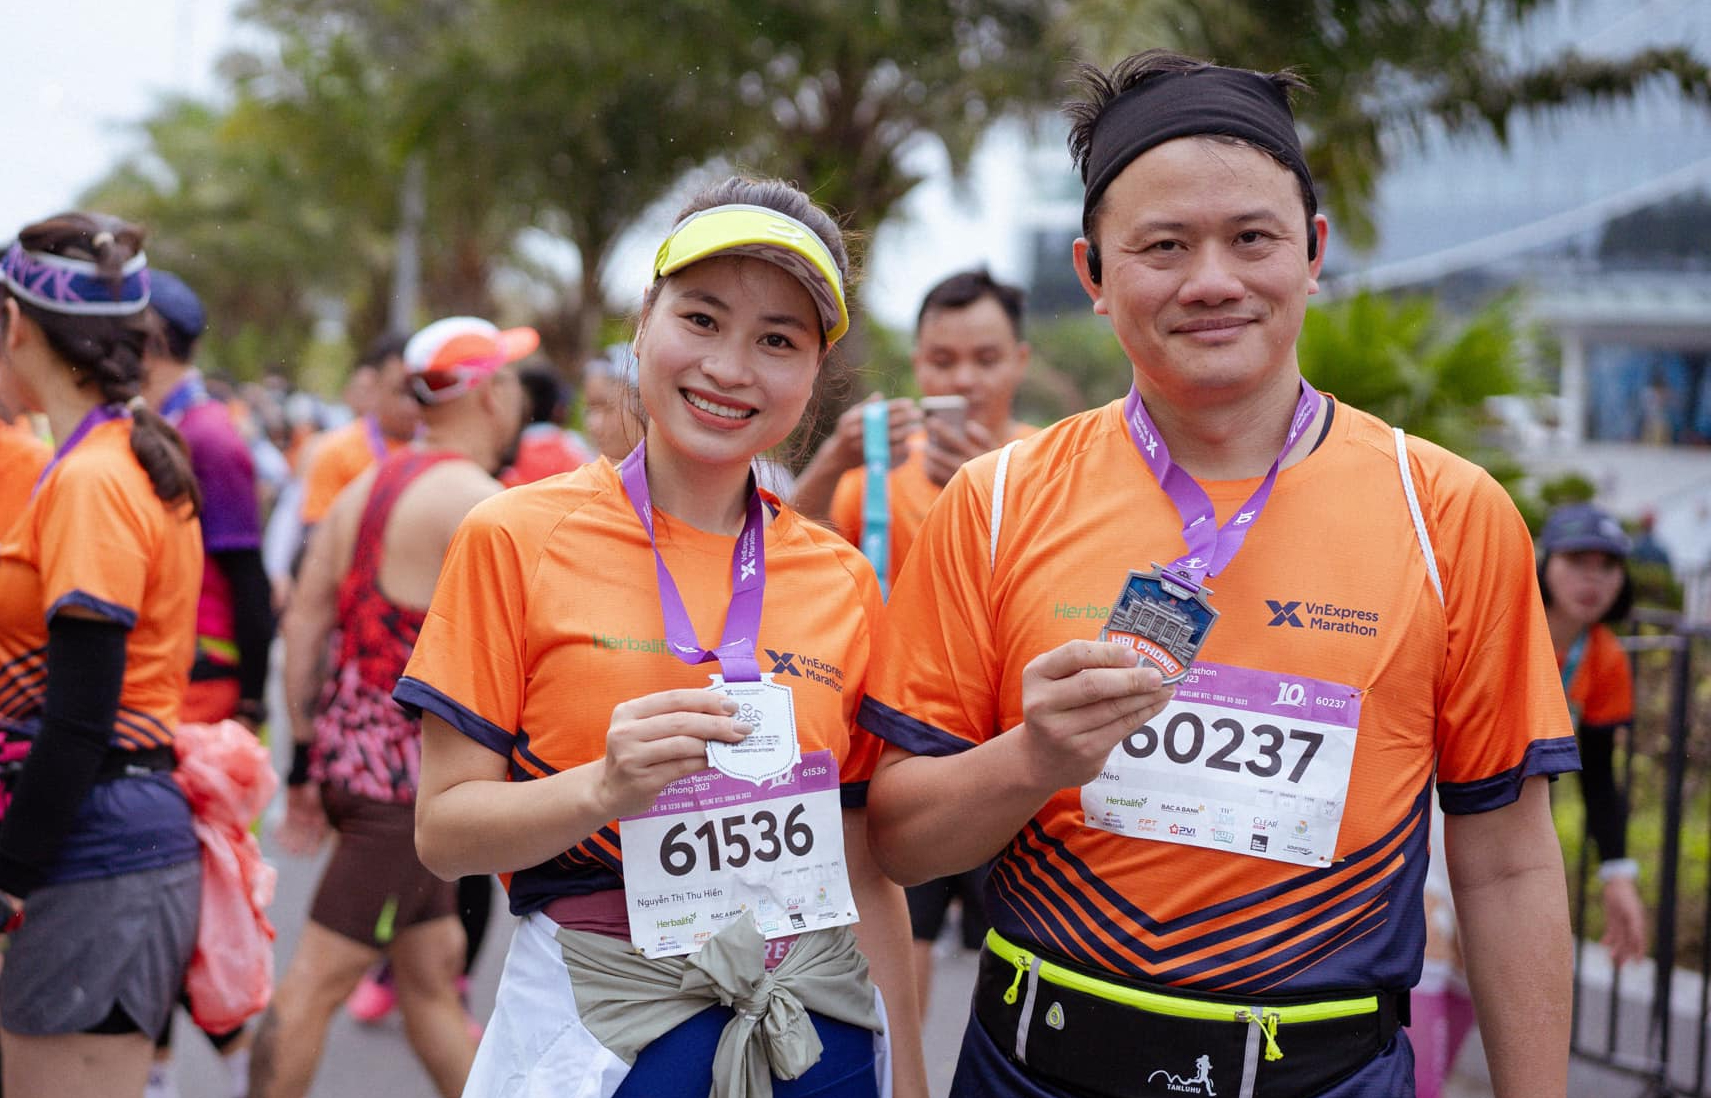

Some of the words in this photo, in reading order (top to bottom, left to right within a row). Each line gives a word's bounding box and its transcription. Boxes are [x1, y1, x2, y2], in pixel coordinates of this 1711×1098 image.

[1055, 599, 1110, 619] Herba
[1305, 602, 1379, 622] VnExpress
[1310, 617, 1377, 637] Marathon
[1137, 640, 1179, 674] PHONG
[1189, 667, 1217, 676] rathon
[1315, 697, 1346, 709] 60237
[691, 773, 723, 784] Marathon
[802, 767, 827, 777] 61536
[667, 784, 694, 797] Phong
[694, 782, 710, 792] 2023
[1106, 795, 1144, 808] Herbalife
[1161, 803, 1175, 812] BAC
[1181, 806, 1199, 814] BANK
[1253, 816, 1278, 828] CLEAR
[1179, 826, 1196, 835] PVI
[660, 803, 814, 876] 61536
[637, 895, 669, 908] Nguyễn
[670, 893, 684, 903] Thị
[686, 891, 702, 901] Thu
[656, 915, 694, 929] Herbalife
